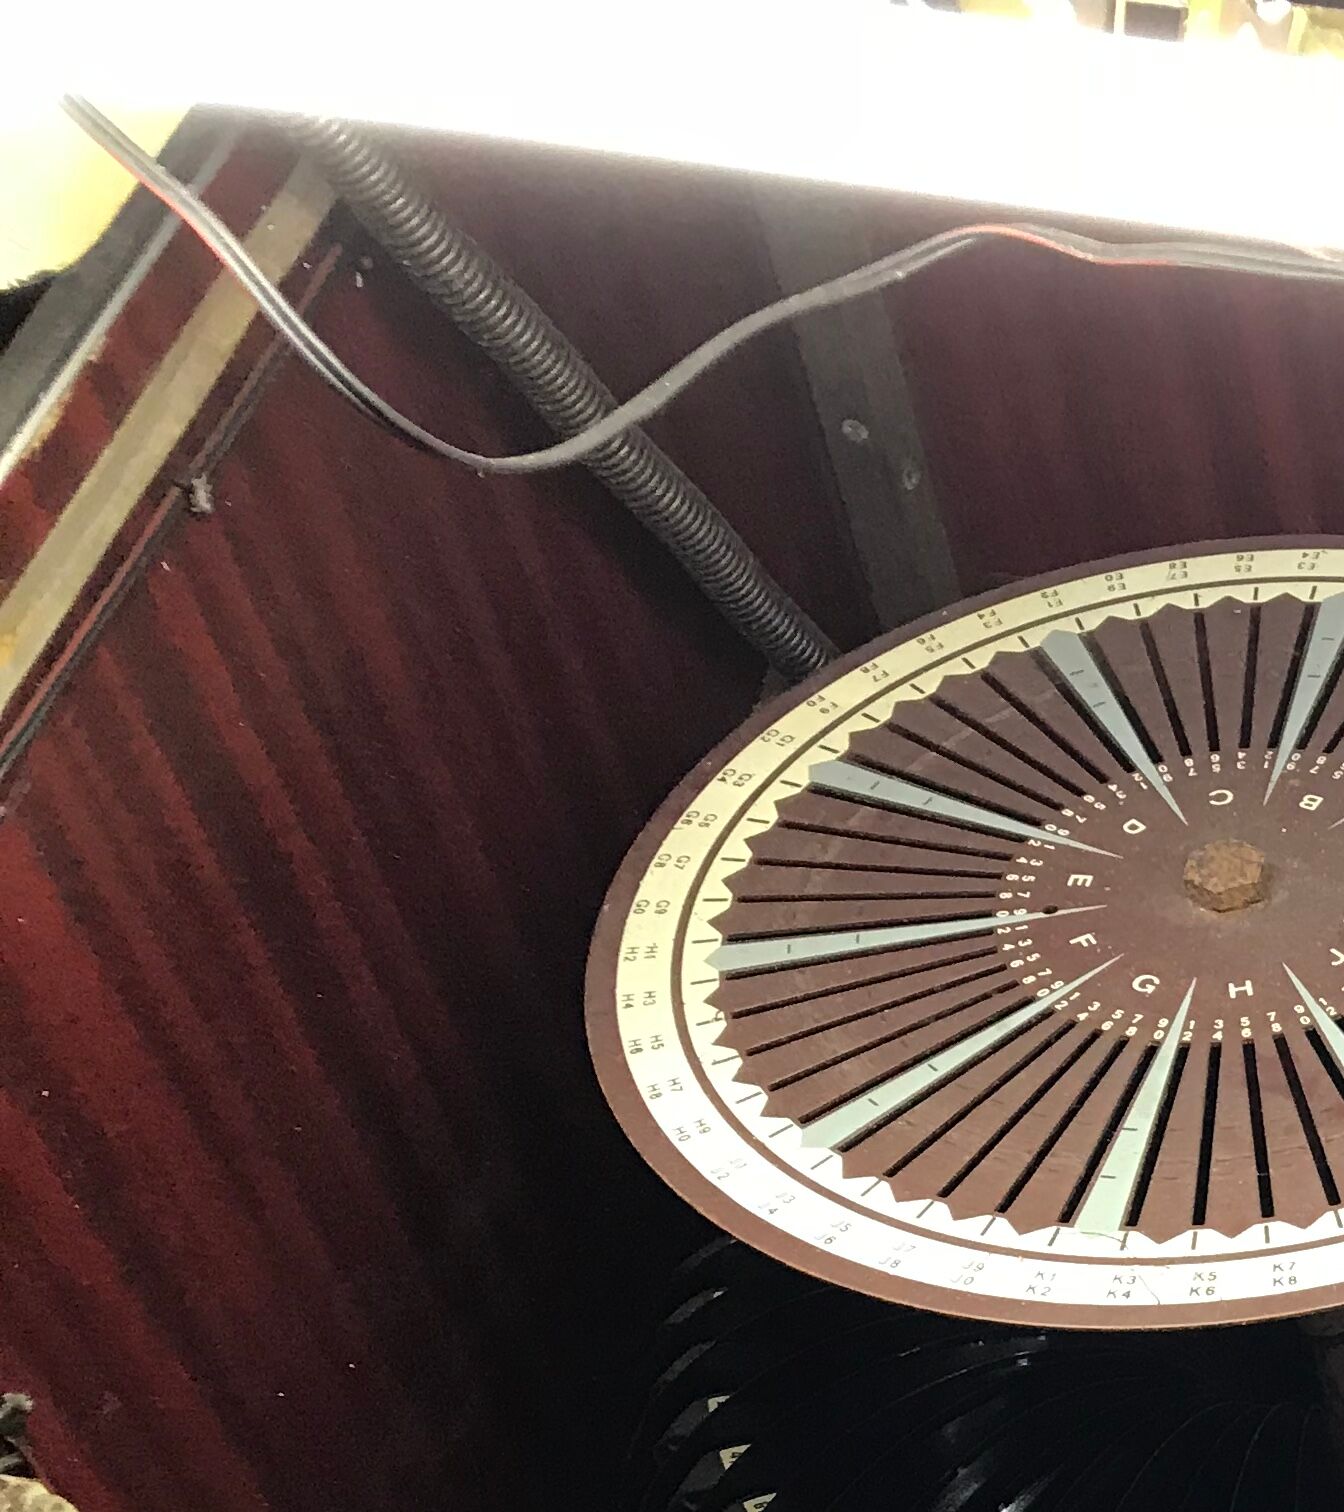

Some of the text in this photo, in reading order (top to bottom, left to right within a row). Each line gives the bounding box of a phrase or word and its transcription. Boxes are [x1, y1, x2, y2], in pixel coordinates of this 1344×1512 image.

[1208, 789, 1234, 806] C
[1299, 794, 1324, 811] B
[1122, 818, 1147, 835] D
[1067, 874, 1094, 888] E
[1069, 933, 1097, 947] F
[1131, 974, 1160, 994] G
[1228, 980, 1254, 999] H
